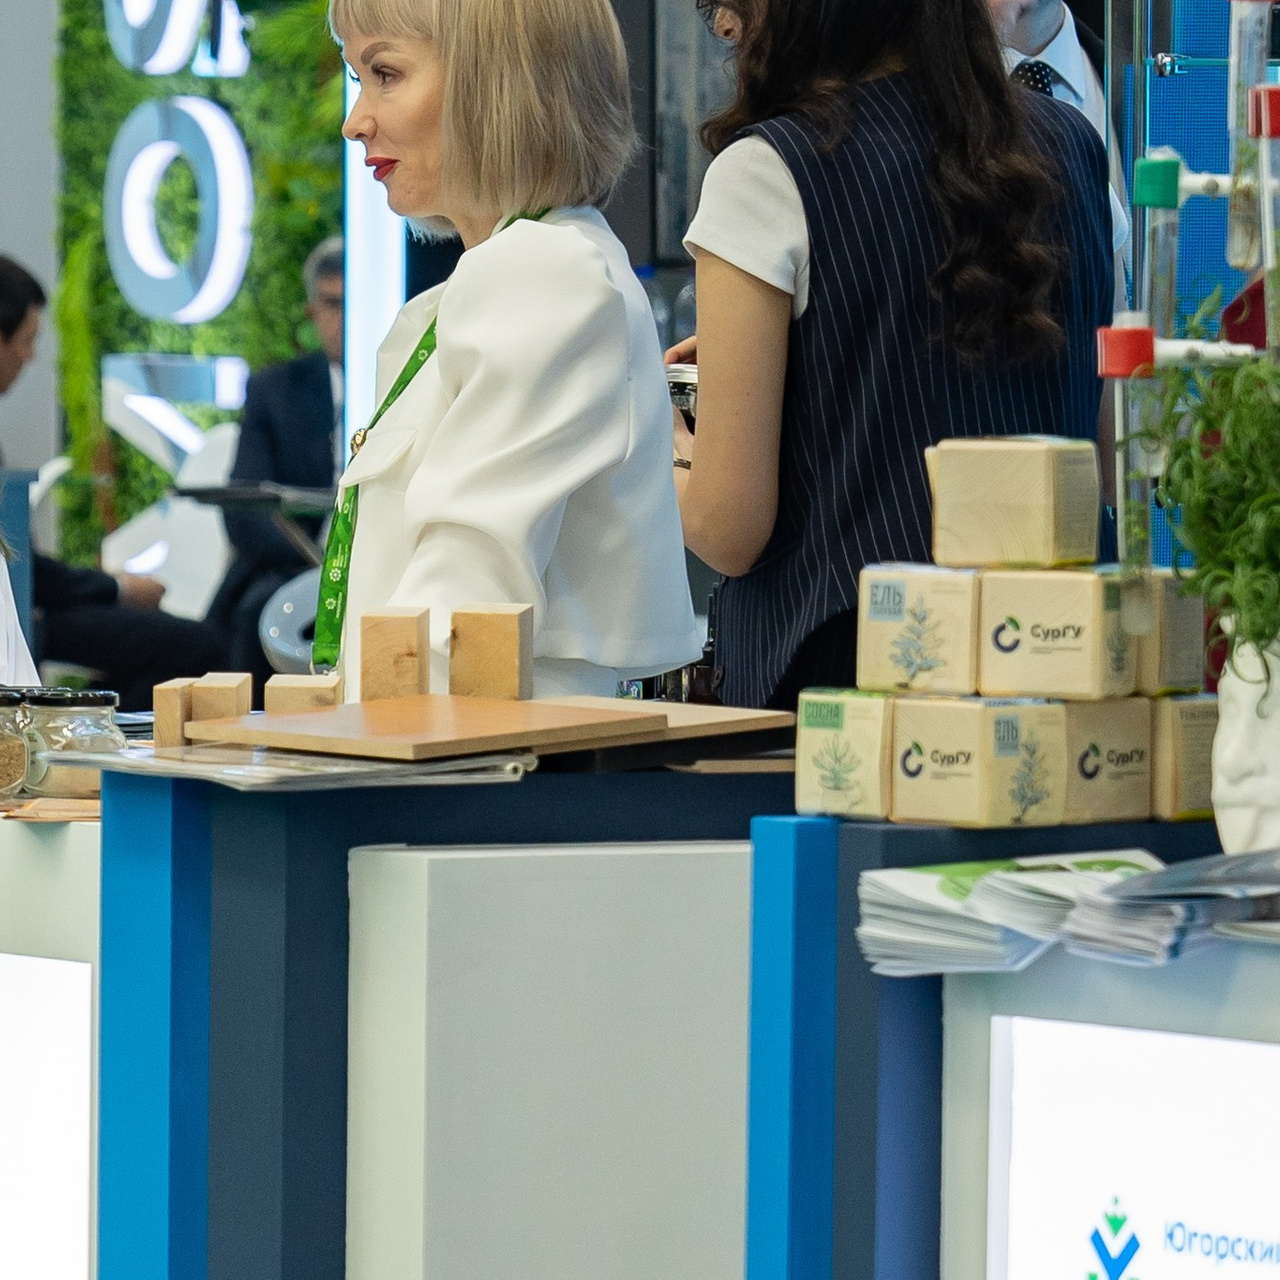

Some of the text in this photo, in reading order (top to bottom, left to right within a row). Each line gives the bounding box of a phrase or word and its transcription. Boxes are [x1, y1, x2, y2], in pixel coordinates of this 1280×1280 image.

[870, 584, 903, 607] ЕЛЬ
[1030, 624, 1082, 641] СурГУ
[930, 750, 971, 767] СурГУ
[1106, 749, 1145, 767] СурГУ
